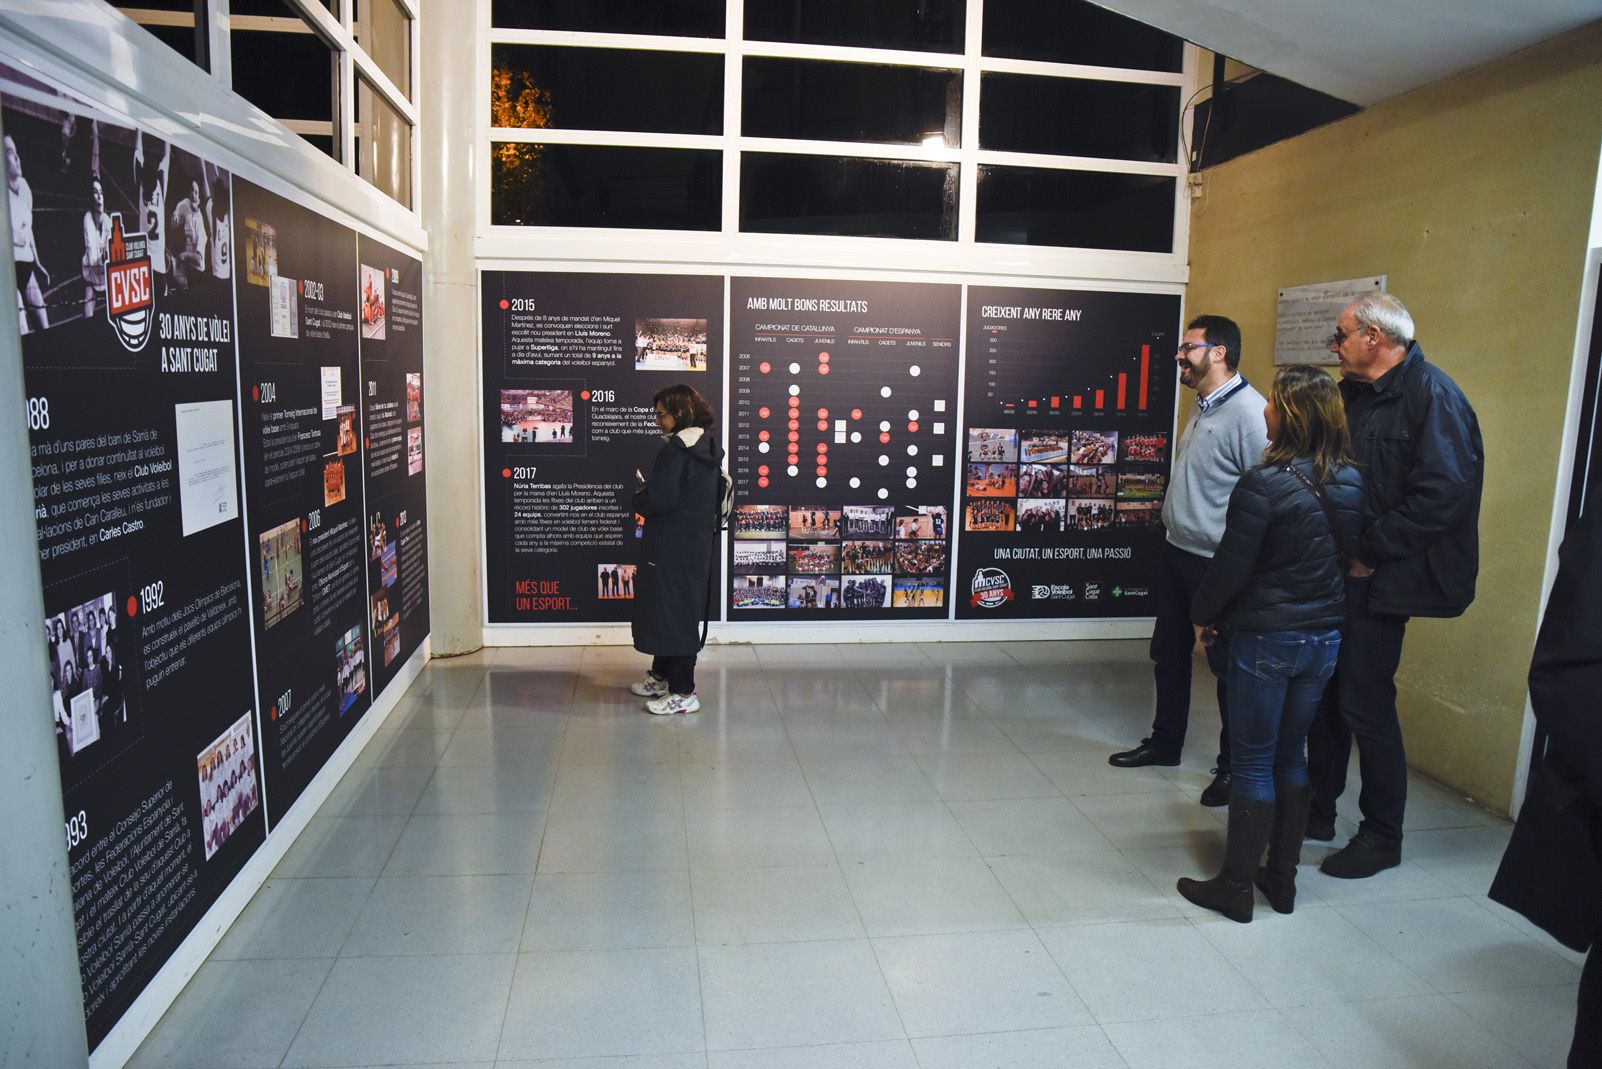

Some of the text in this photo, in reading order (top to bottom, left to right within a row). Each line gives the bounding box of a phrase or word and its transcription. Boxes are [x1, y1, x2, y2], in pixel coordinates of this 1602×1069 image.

[147, 210, 159, 240] 2
[112, 266, 150, 308] CVSC
[305, 280, 324, 301] 2002-03
[512, 298, 535, 311] 2015
[747, 297, 868, 313] AMB MOLT BONS RESULTATS
[982, 306, 1082, 321] CREIXENT ANY RERE ANY
[159, 312, 230, 343] 30 ANYS DE VÒLEI
[854, 326, 888, 334] CAMPIONAT
[161, 347, 218, 372] A SANT CUGAT
[260, 382, 276, 403] 2004
[592, 390, 615, 402] 2016
[134, 464, 149, 477] Club
[150, 459, 172, 474] Voleibol
[514, 467, 536, 479] 2017
[99, 526, 121, 541] Carles
[122, 520, 144, 534] Castro
[994, 547, 1131, 560] UNA CIUTAT, UN ESPORT, UNA PASSIÓ
[516, 579, 560, 594] MÉS QUE
[986, 574, 1005, 586] CVSC
[140, 580, 164, 614] 1992
[980, 590, 1004, 599] 30 ANYS
[517, 597, 530, 610] UN
[278, 688, 291, 718] 2007
